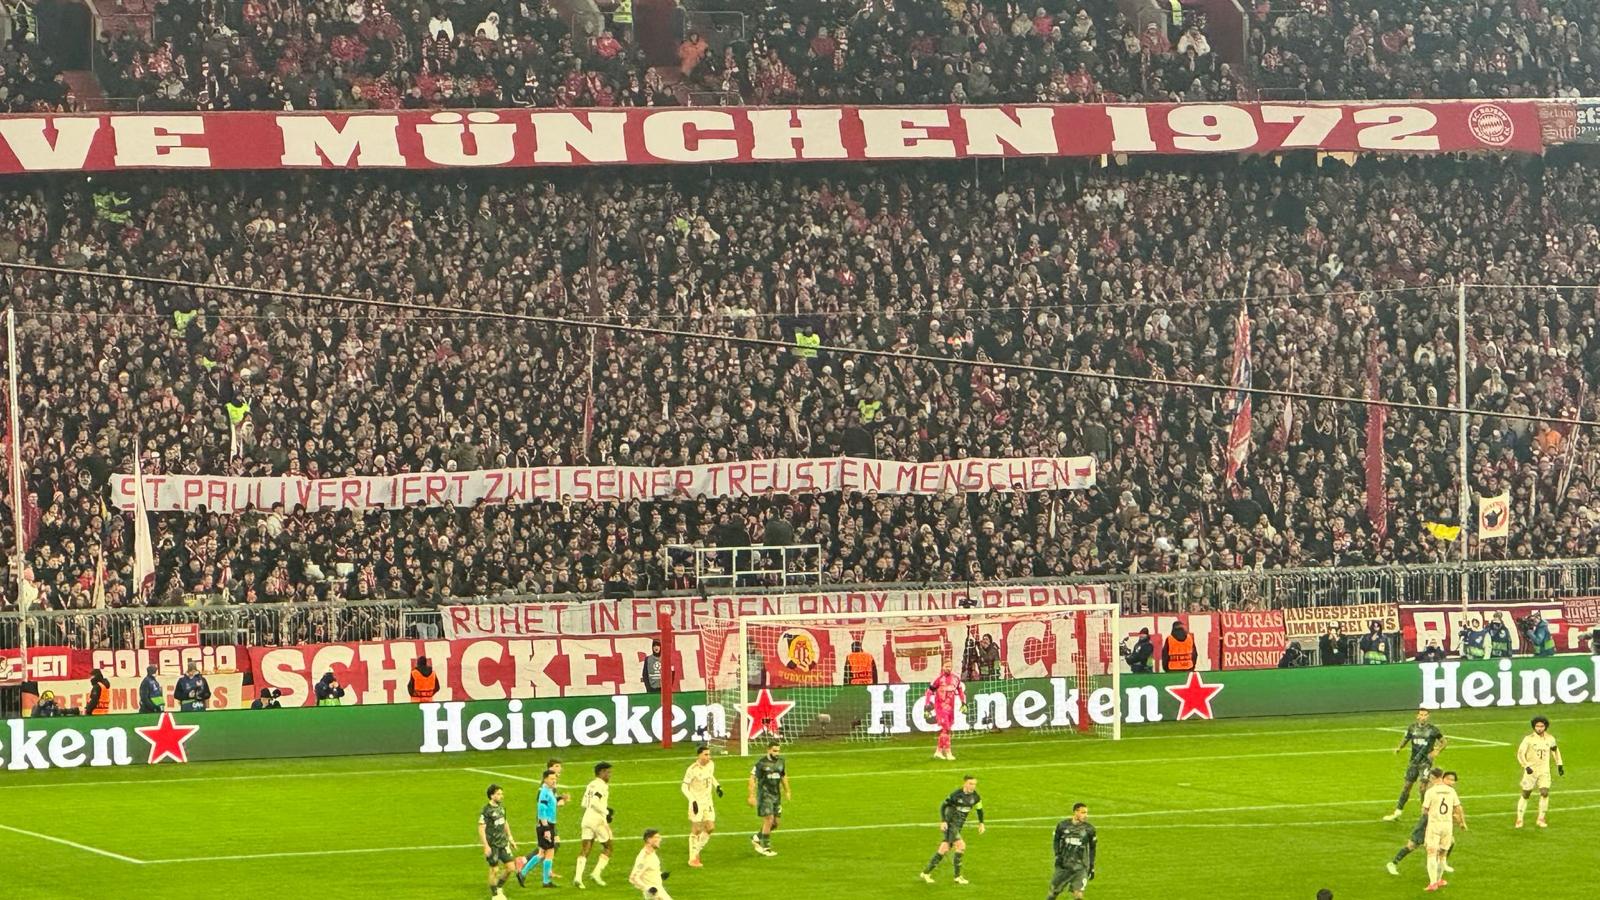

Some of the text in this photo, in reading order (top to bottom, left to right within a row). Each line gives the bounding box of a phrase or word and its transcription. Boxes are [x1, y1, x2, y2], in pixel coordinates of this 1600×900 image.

[276, 108, 1059, 167] MÜNCHEN
[1106, 104, 1440, 151] 1972
[296, 475, 470, 510] VERLIERT
[483, 468, 560, 507] ZWEI
[573, 469, 692, 499] SEINER
[707, 460, 882, 496] TREUSTEN
[450, 603, 568, 634] RUHET
[591, 598, 619, 632] IN
[633, 597, 781, 631] FRIEDEN
[799, 592, 889, 625] ANDY
[1223, 611, 1284, 629] ULTRAS
[1287, 605, 1397, 621] AUSGESPERRTE
[1288, 622, 1330, 636] IMME
[1223, 631, 1286, 648] GEGEN
[418, 695, 732, 753] Heineken
[1439, 797, 1449, 815] 6
